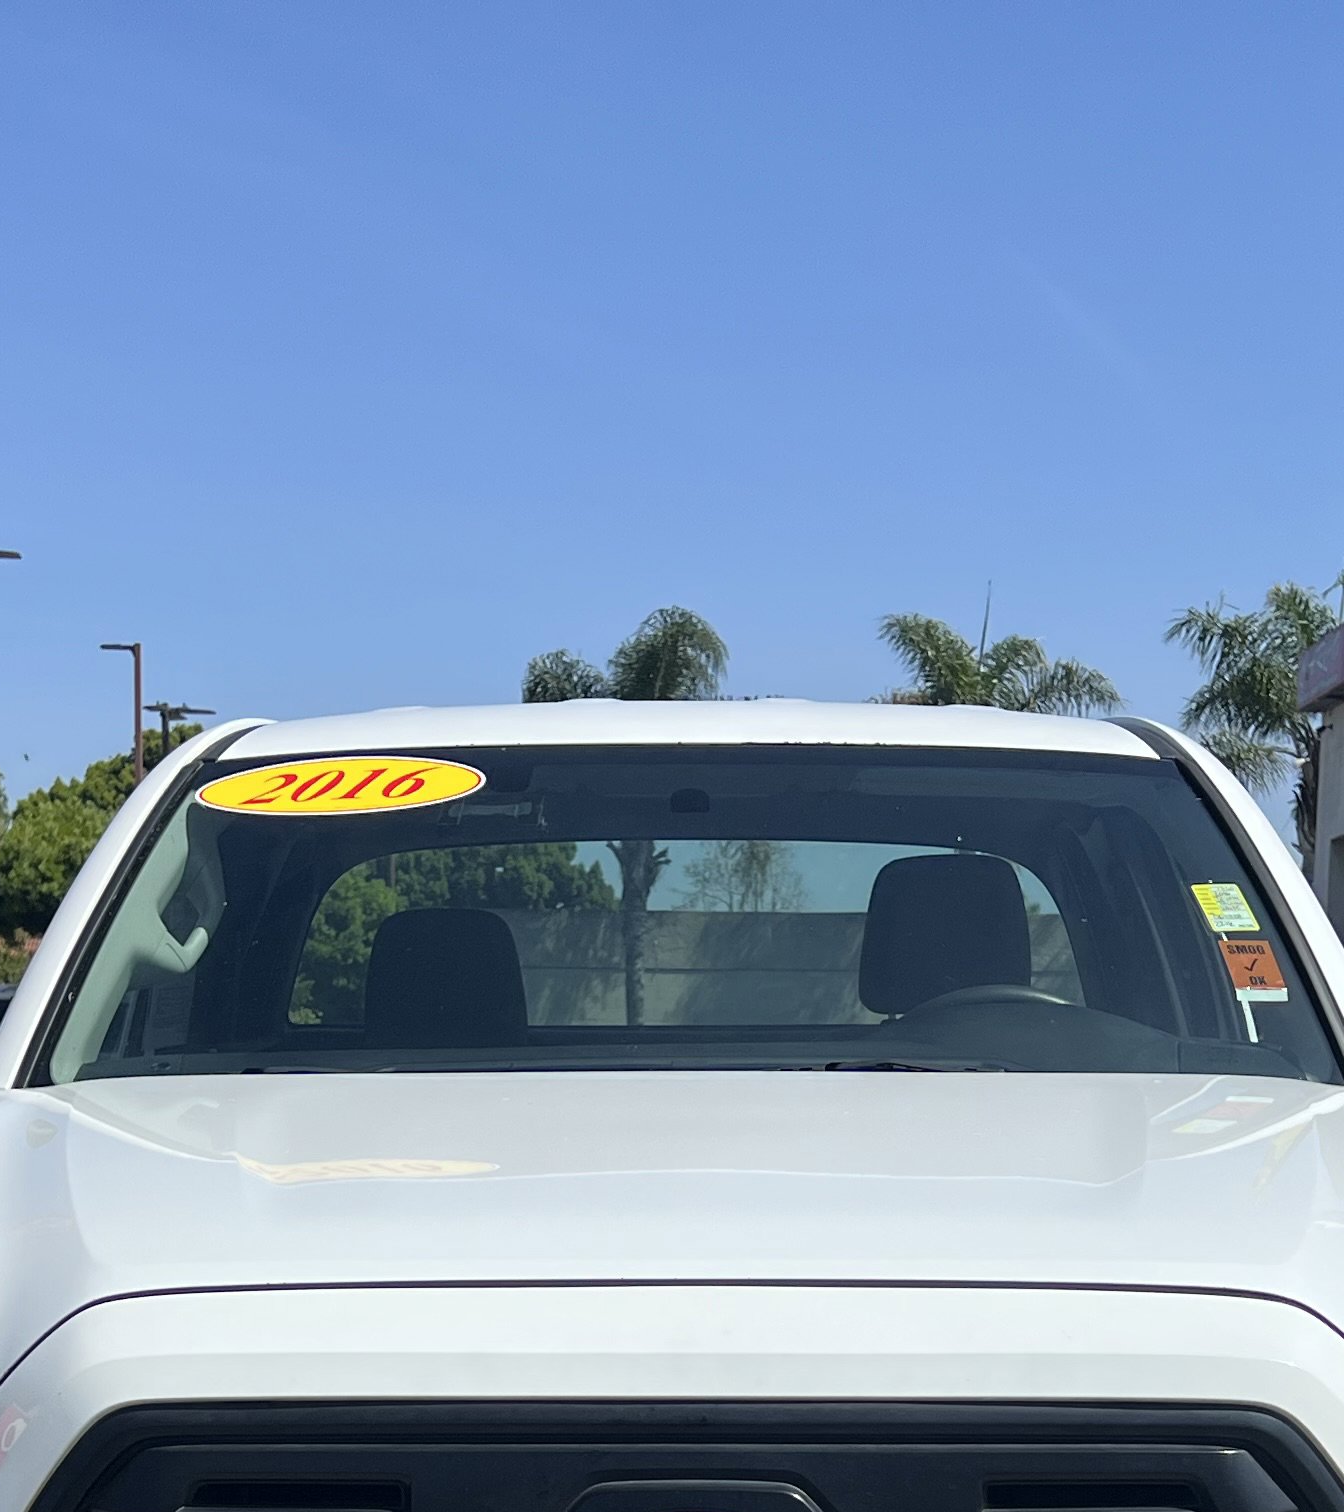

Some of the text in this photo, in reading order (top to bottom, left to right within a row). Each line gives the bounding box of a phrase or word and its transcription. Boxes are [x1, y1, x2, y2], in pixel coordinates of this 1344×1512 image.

[238, 766, 443, 805] 2016
[1226, 944, 1266, 955] SMOG
[1249, 975, 1267, 985] OK
